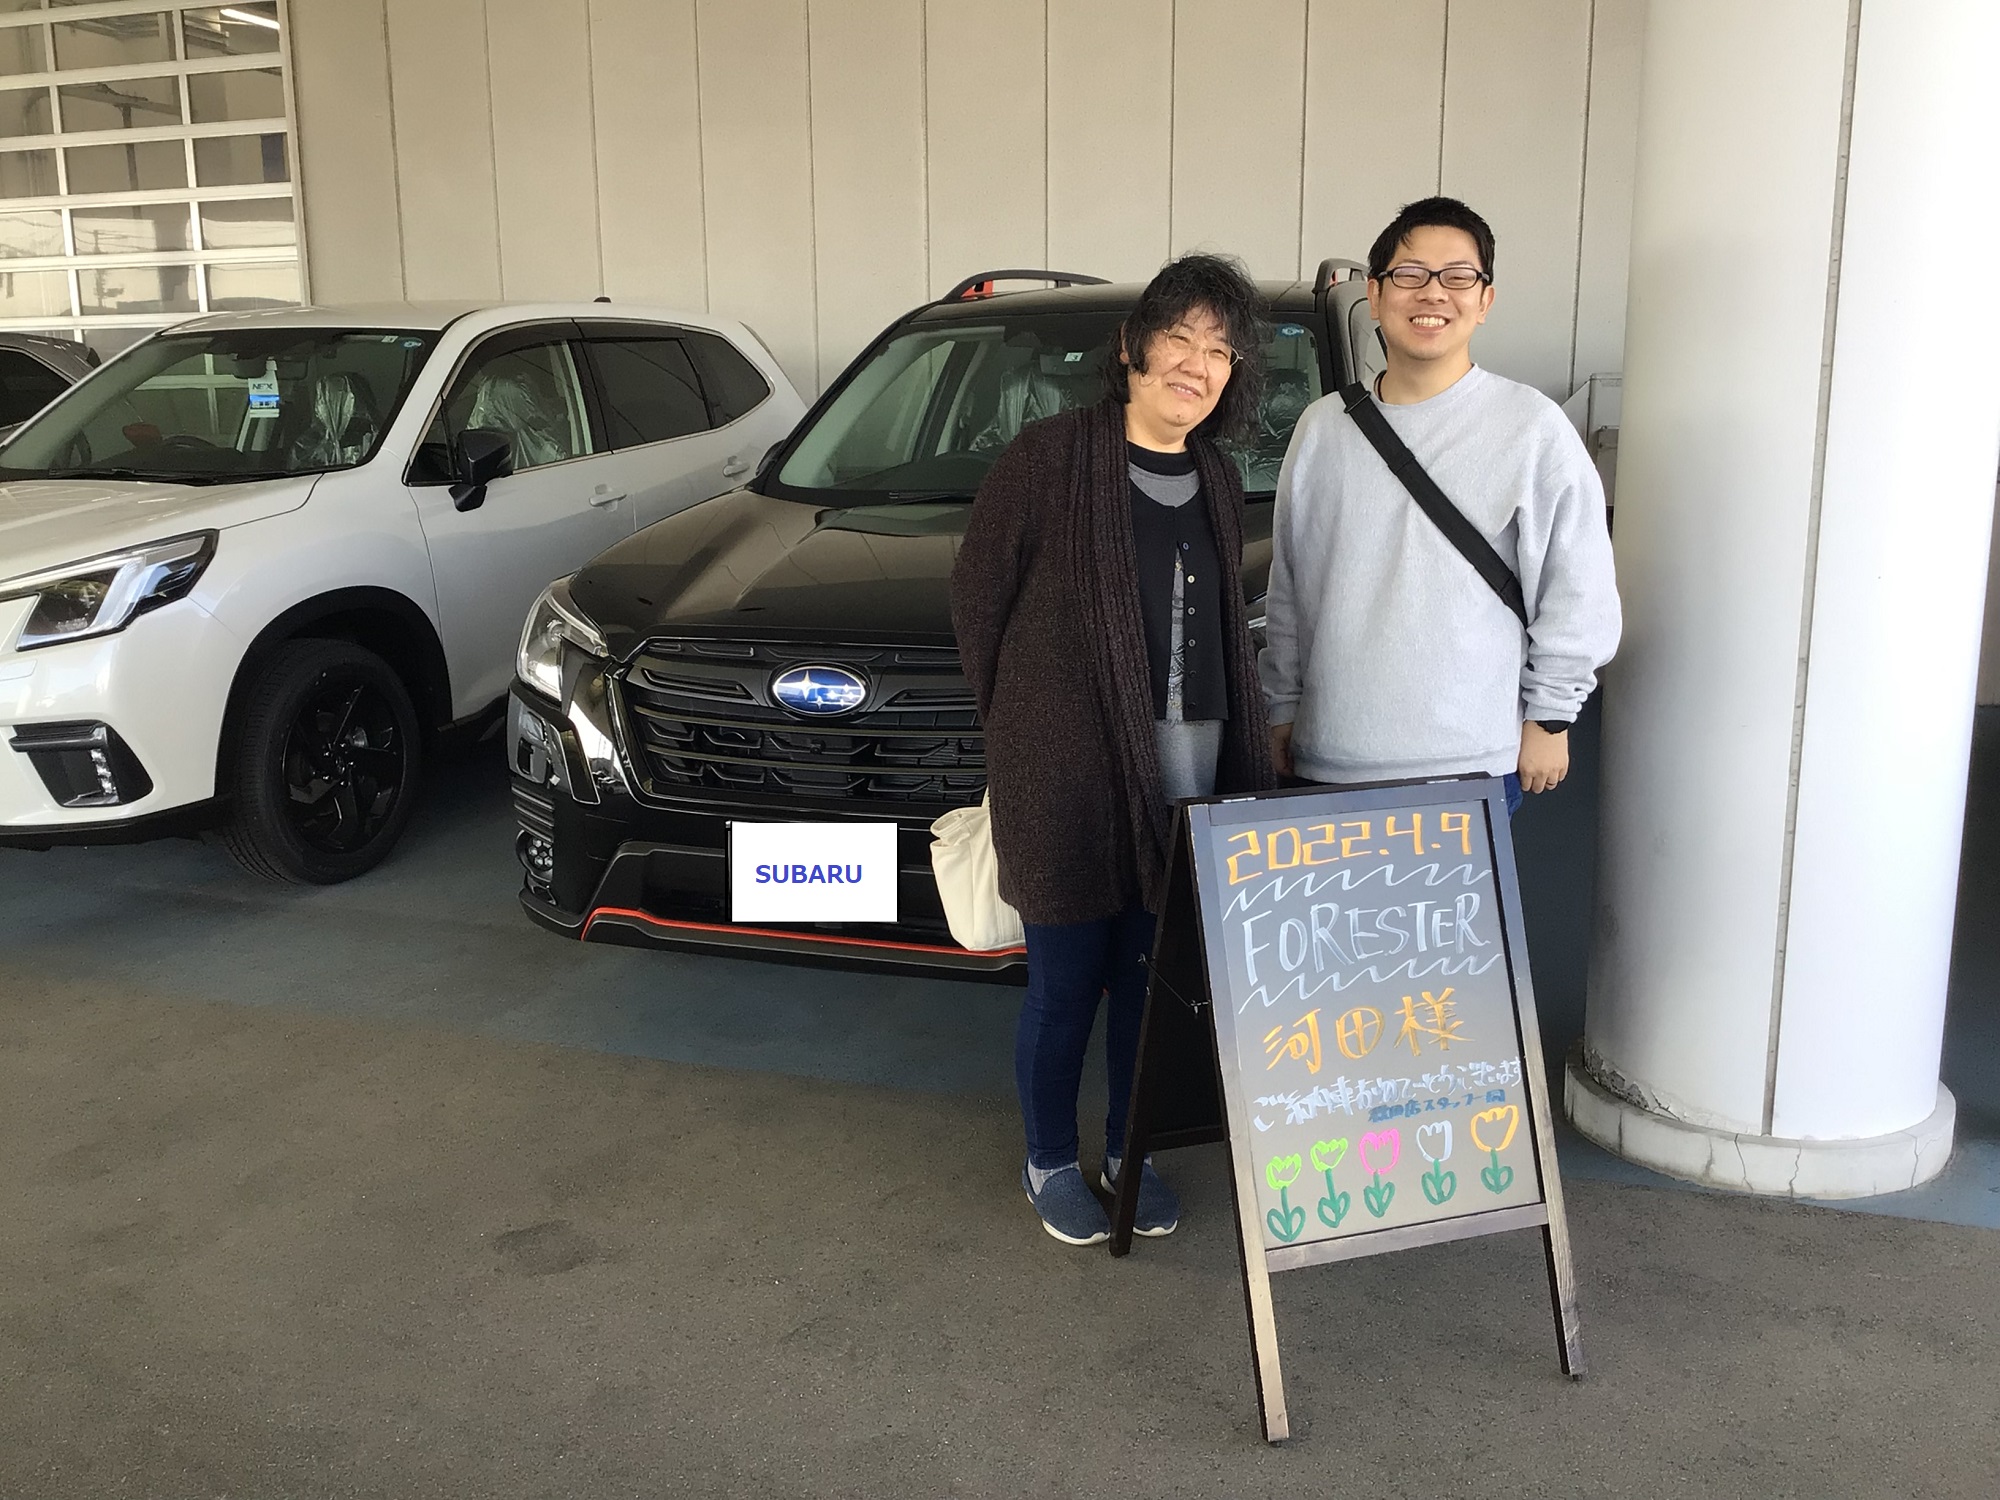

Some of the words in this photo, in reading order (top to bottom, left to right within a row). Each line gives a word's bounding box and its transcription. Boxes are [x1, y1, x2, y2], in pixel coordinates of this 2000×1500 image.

[1227, 812, 1472, 886] 2022.4.9
[1242, 892, 1492, 987] FORESTER
[1263, 987, 1476, 1075] 河田様
